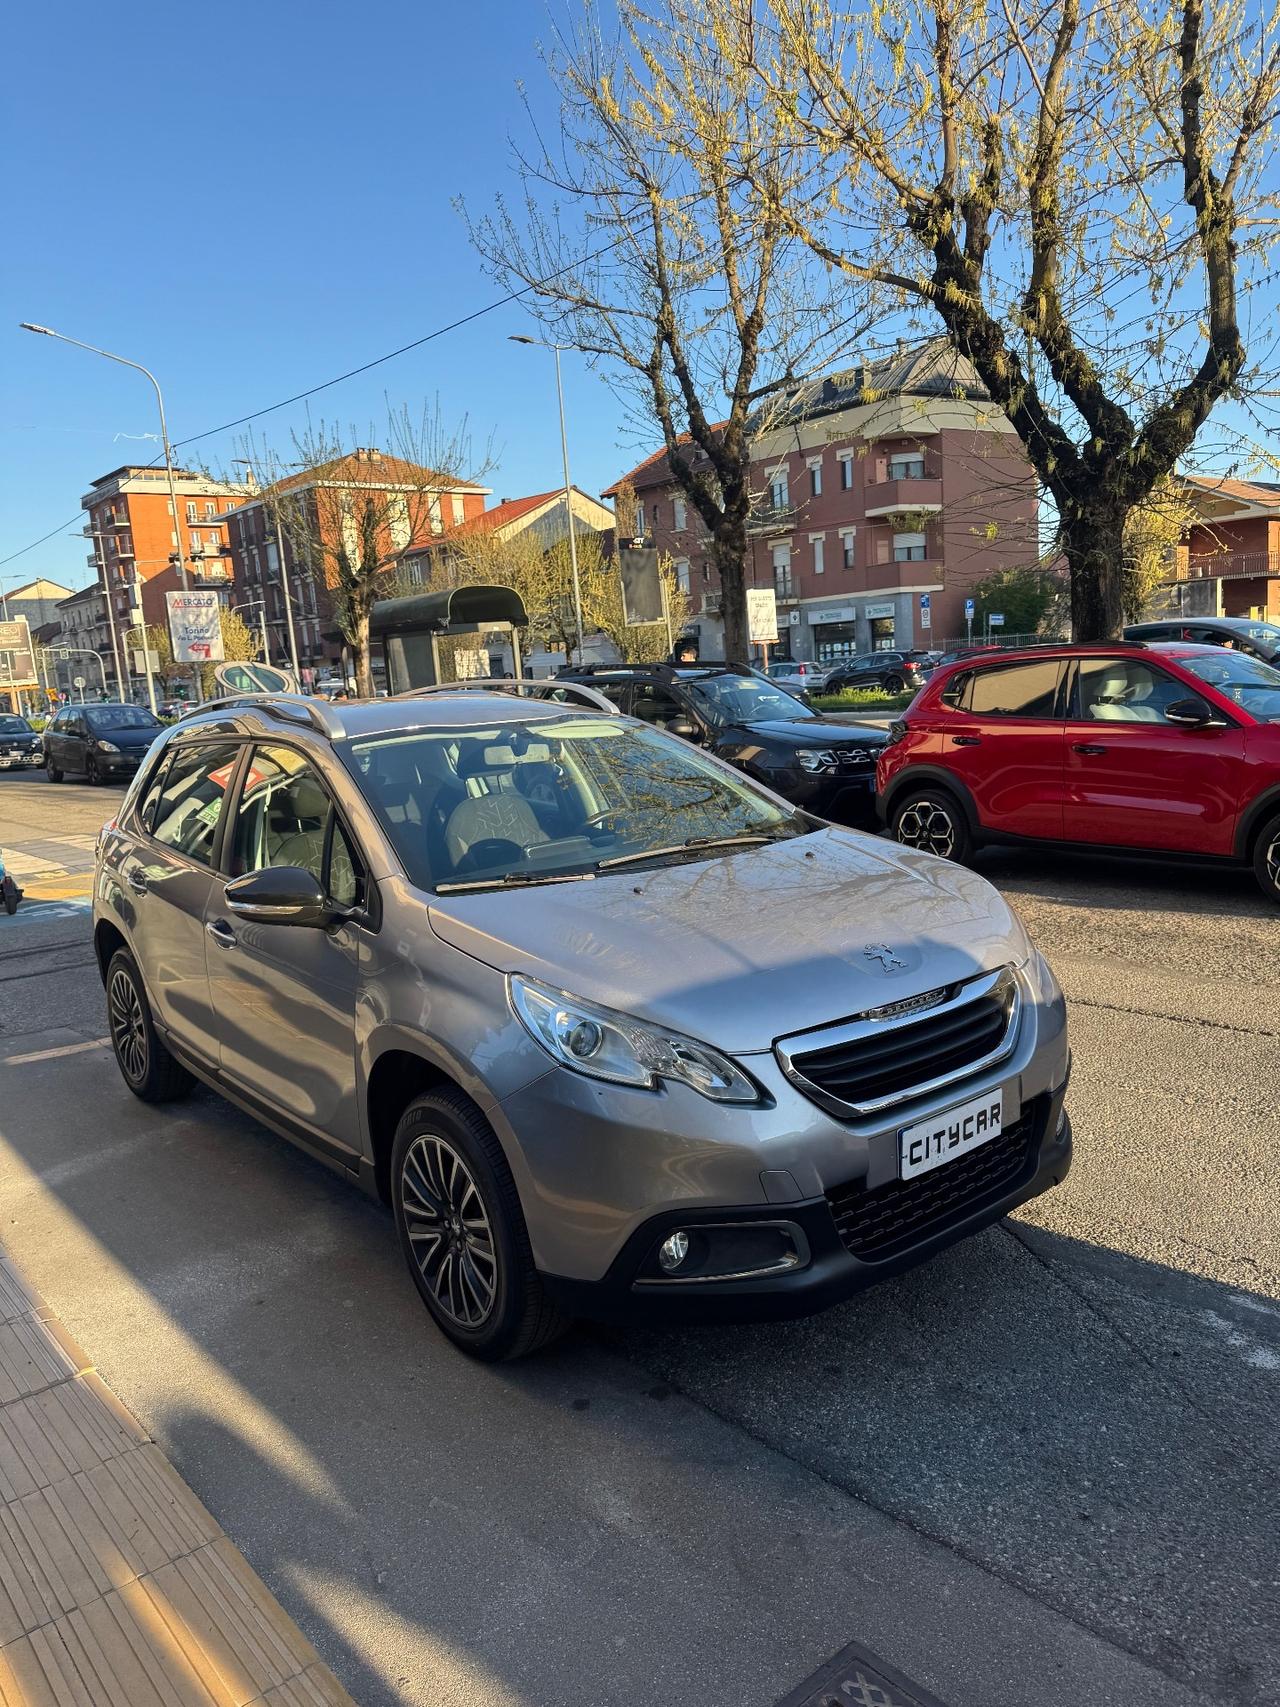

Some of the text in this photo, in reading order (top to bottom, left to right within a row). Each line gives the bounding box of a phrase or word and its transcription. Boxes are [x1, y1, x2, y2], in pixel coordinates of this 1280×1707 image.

[172, 598, 213, 608] MERCATO
[184, 626, 209, 635] Torino
[910, 1102, 1001, 1166] CITYCAR
